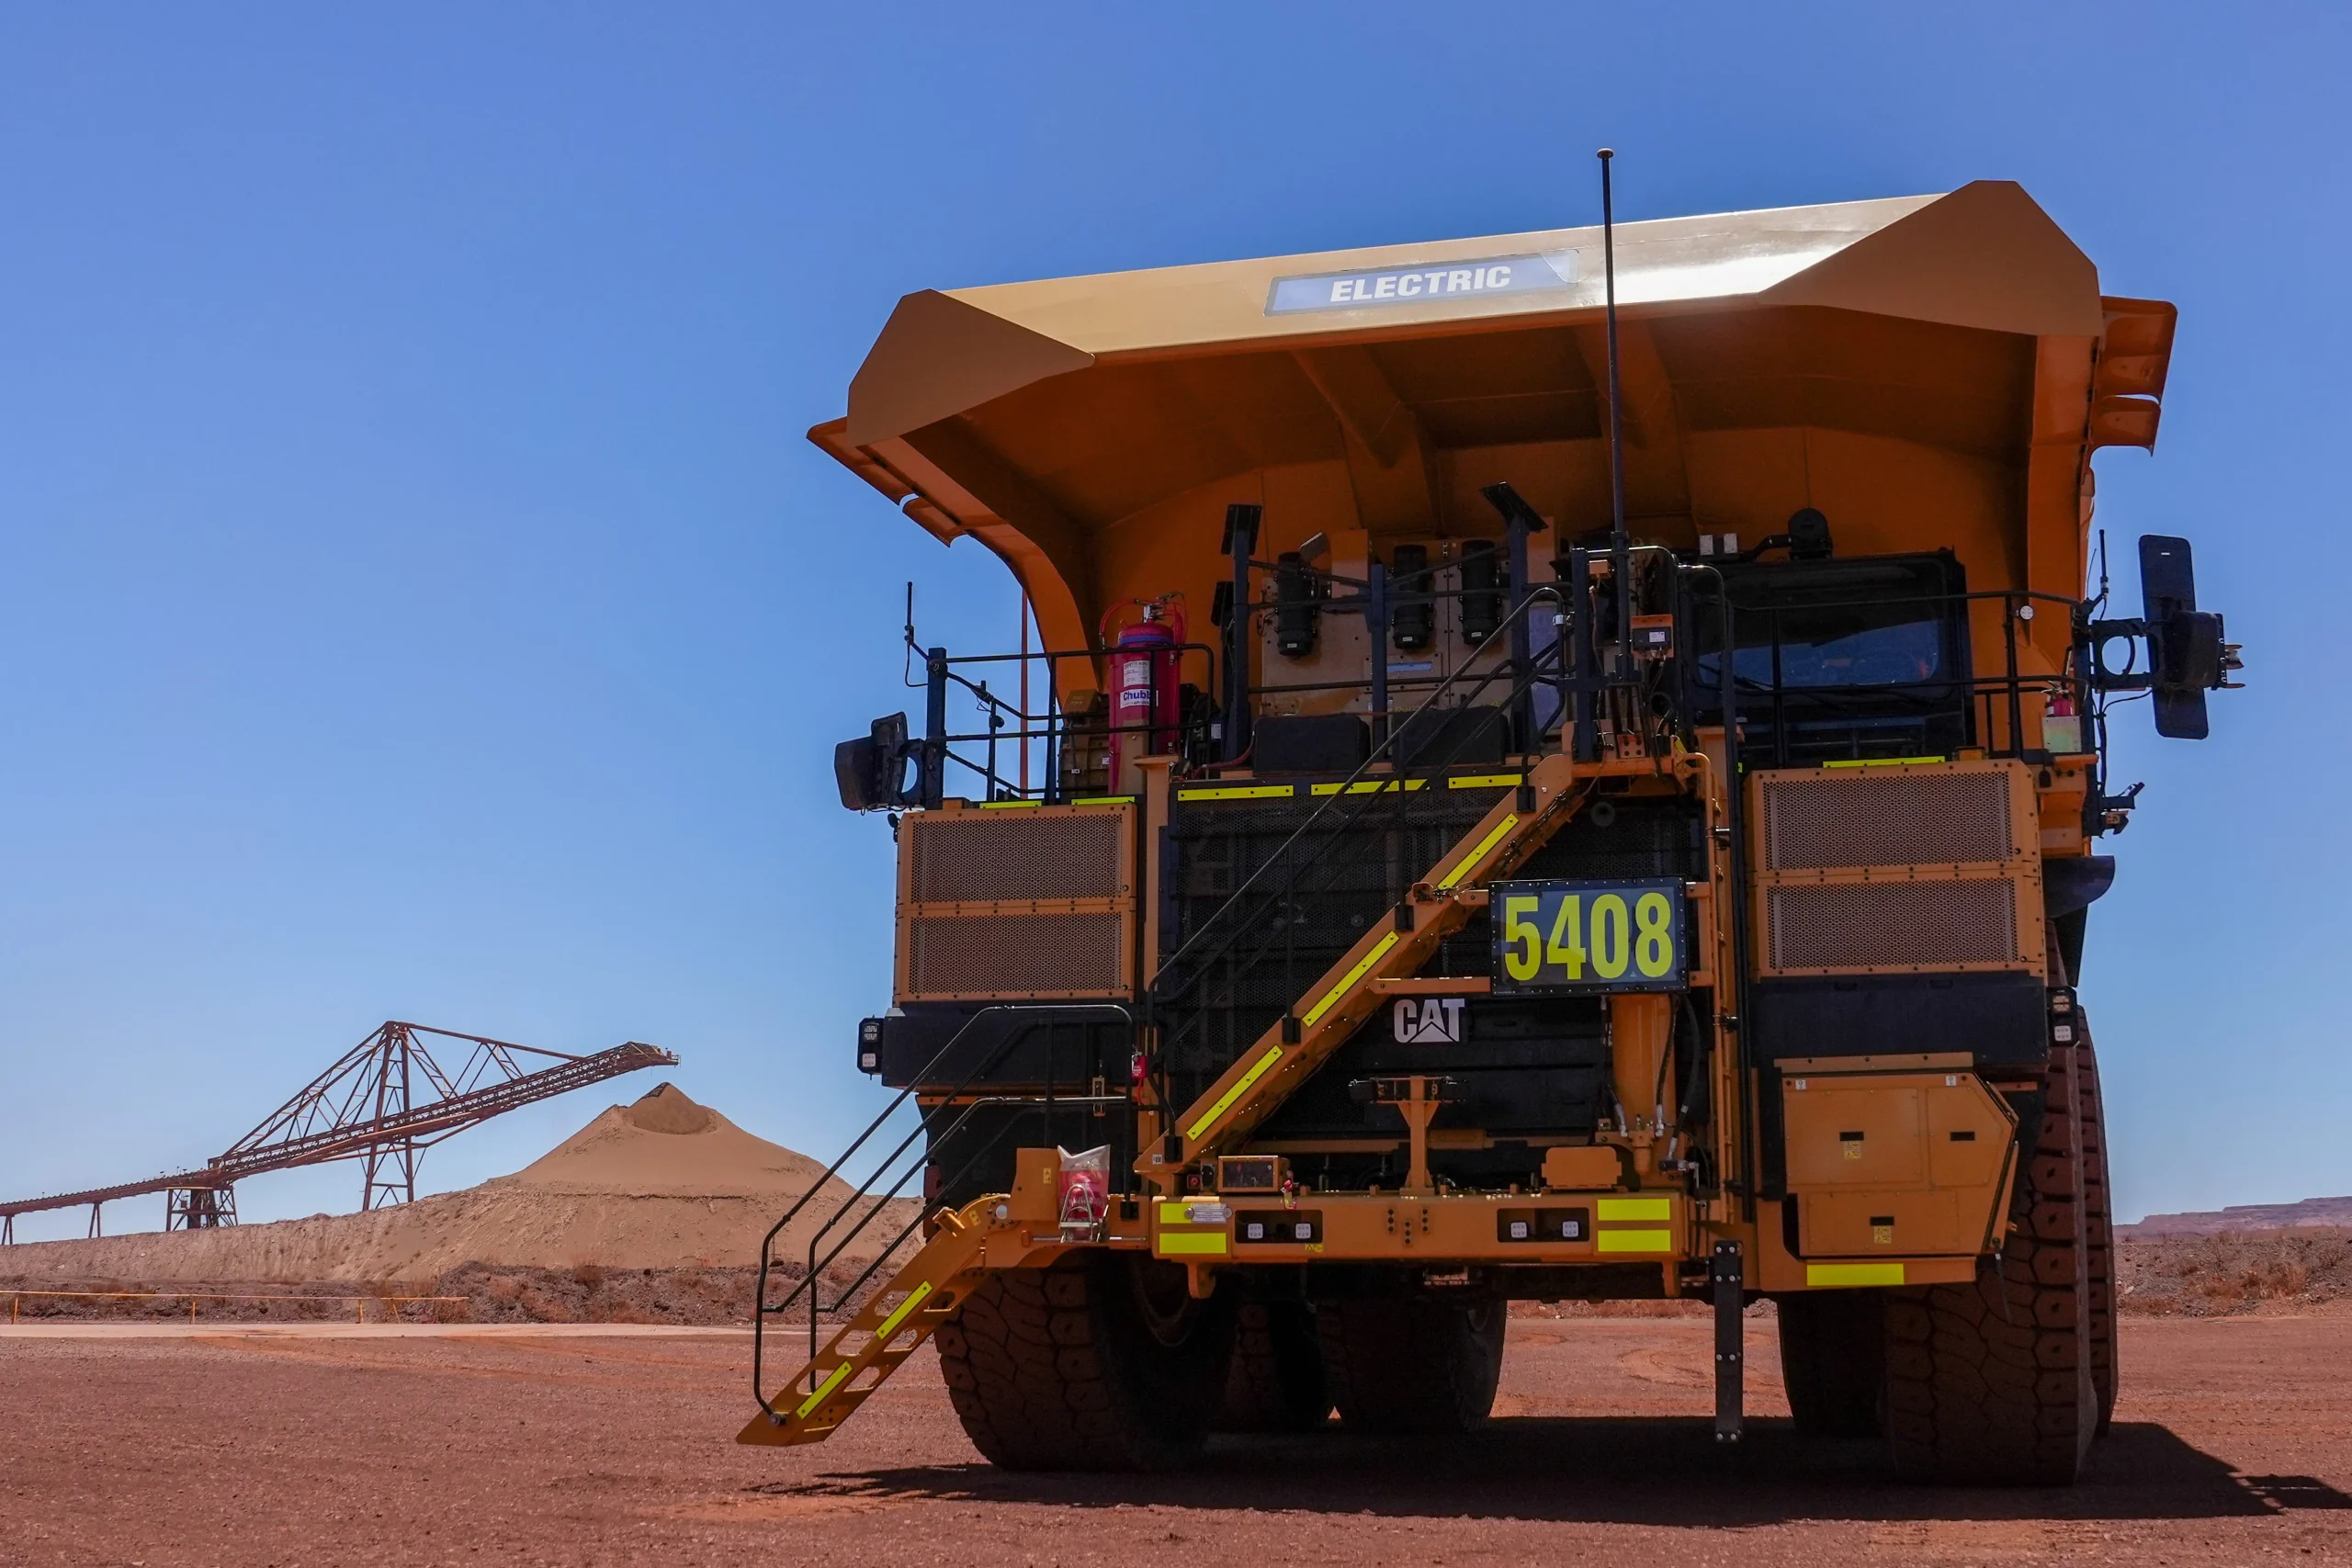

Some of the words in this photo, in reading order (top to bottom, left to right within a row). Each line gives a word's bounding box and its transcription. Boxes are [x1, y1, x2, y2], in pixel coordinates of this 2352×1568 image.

[1330, 265, 1511, 302] ELECTRIC
[1504, 892, 1673, 981] 5408
[1394, 998, 1465, 1043] CAT
